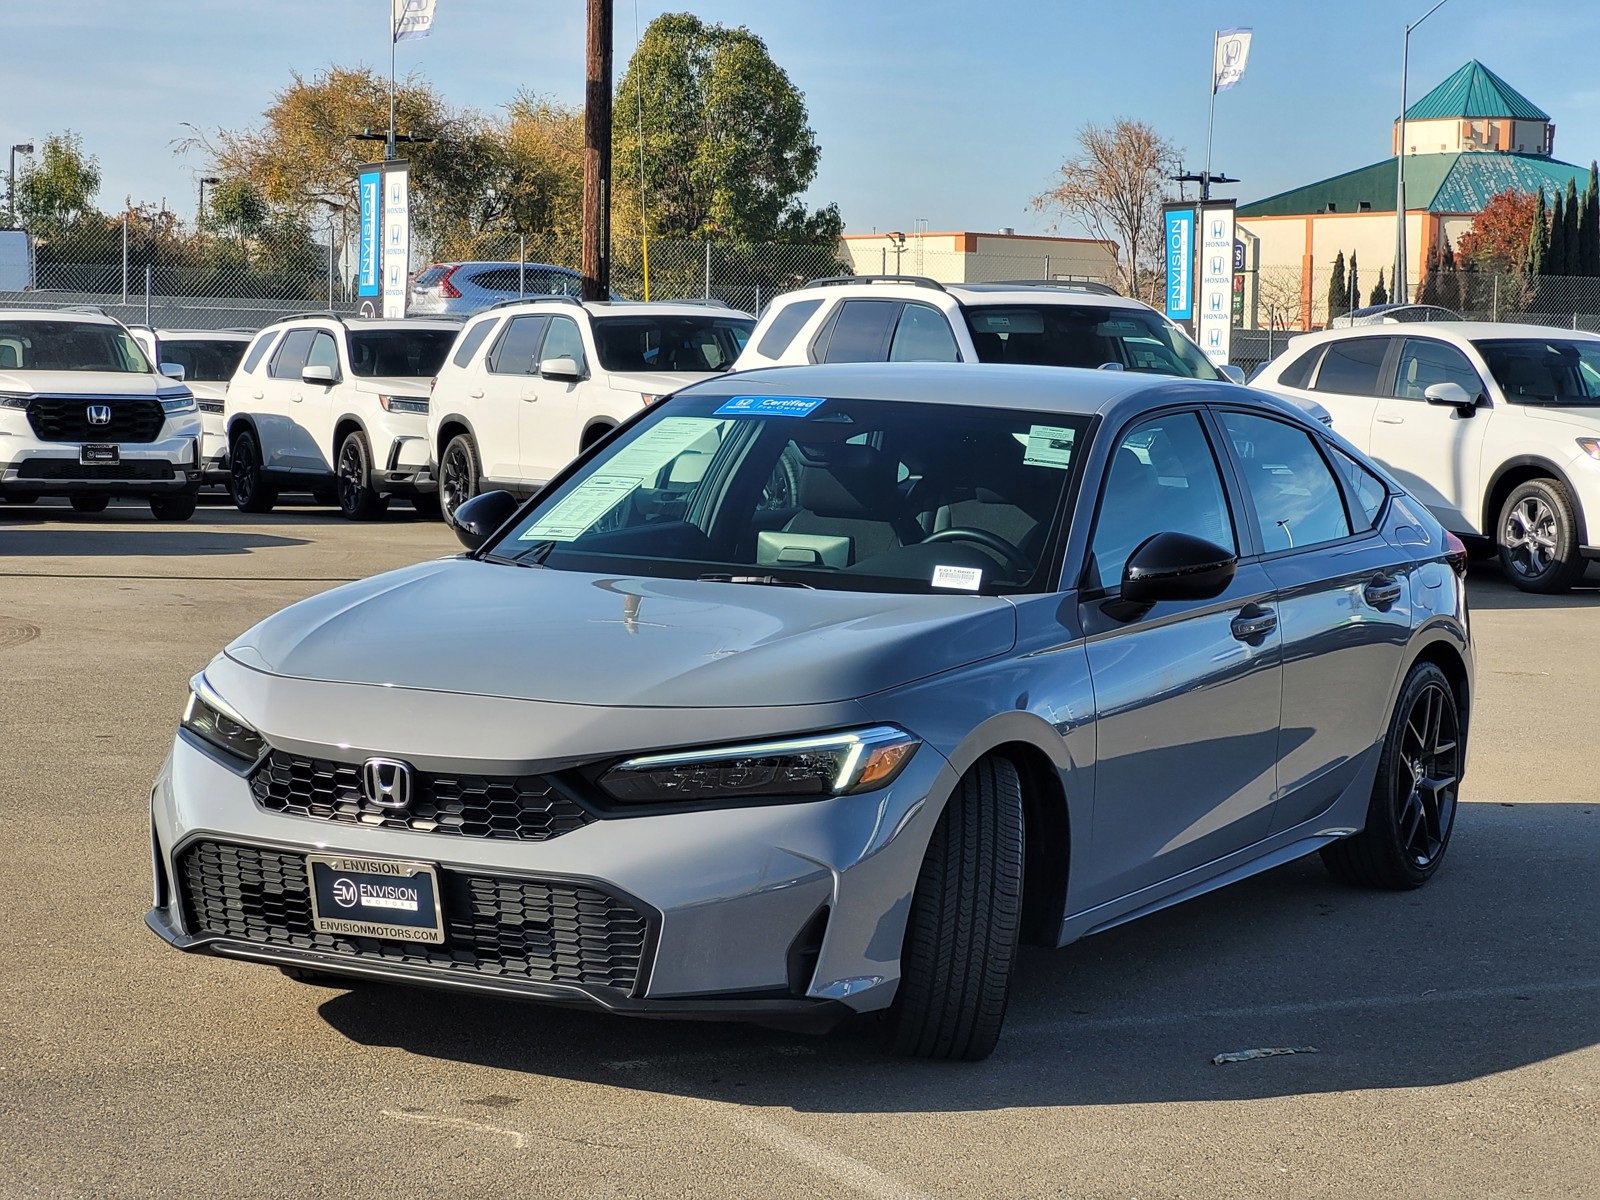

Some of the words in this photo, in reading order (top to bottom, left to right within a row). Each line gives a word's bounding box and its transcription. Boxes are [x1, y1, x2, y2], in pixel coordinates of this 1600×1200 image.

[386, 207, 407, 215] HONDA
[361, 183, 371, 286] ENVISION
[1171, 219, 1181, 311] ENVISION
[762, 399, 817, 408] Certified
[343, 860, 400, 874] ENVISION
[359, 884, 418, 901] ENVISION
[365, 899, 414, 909] MOTORS
[320, 921, 439, 941] ENVISIONMOTORS.COM
